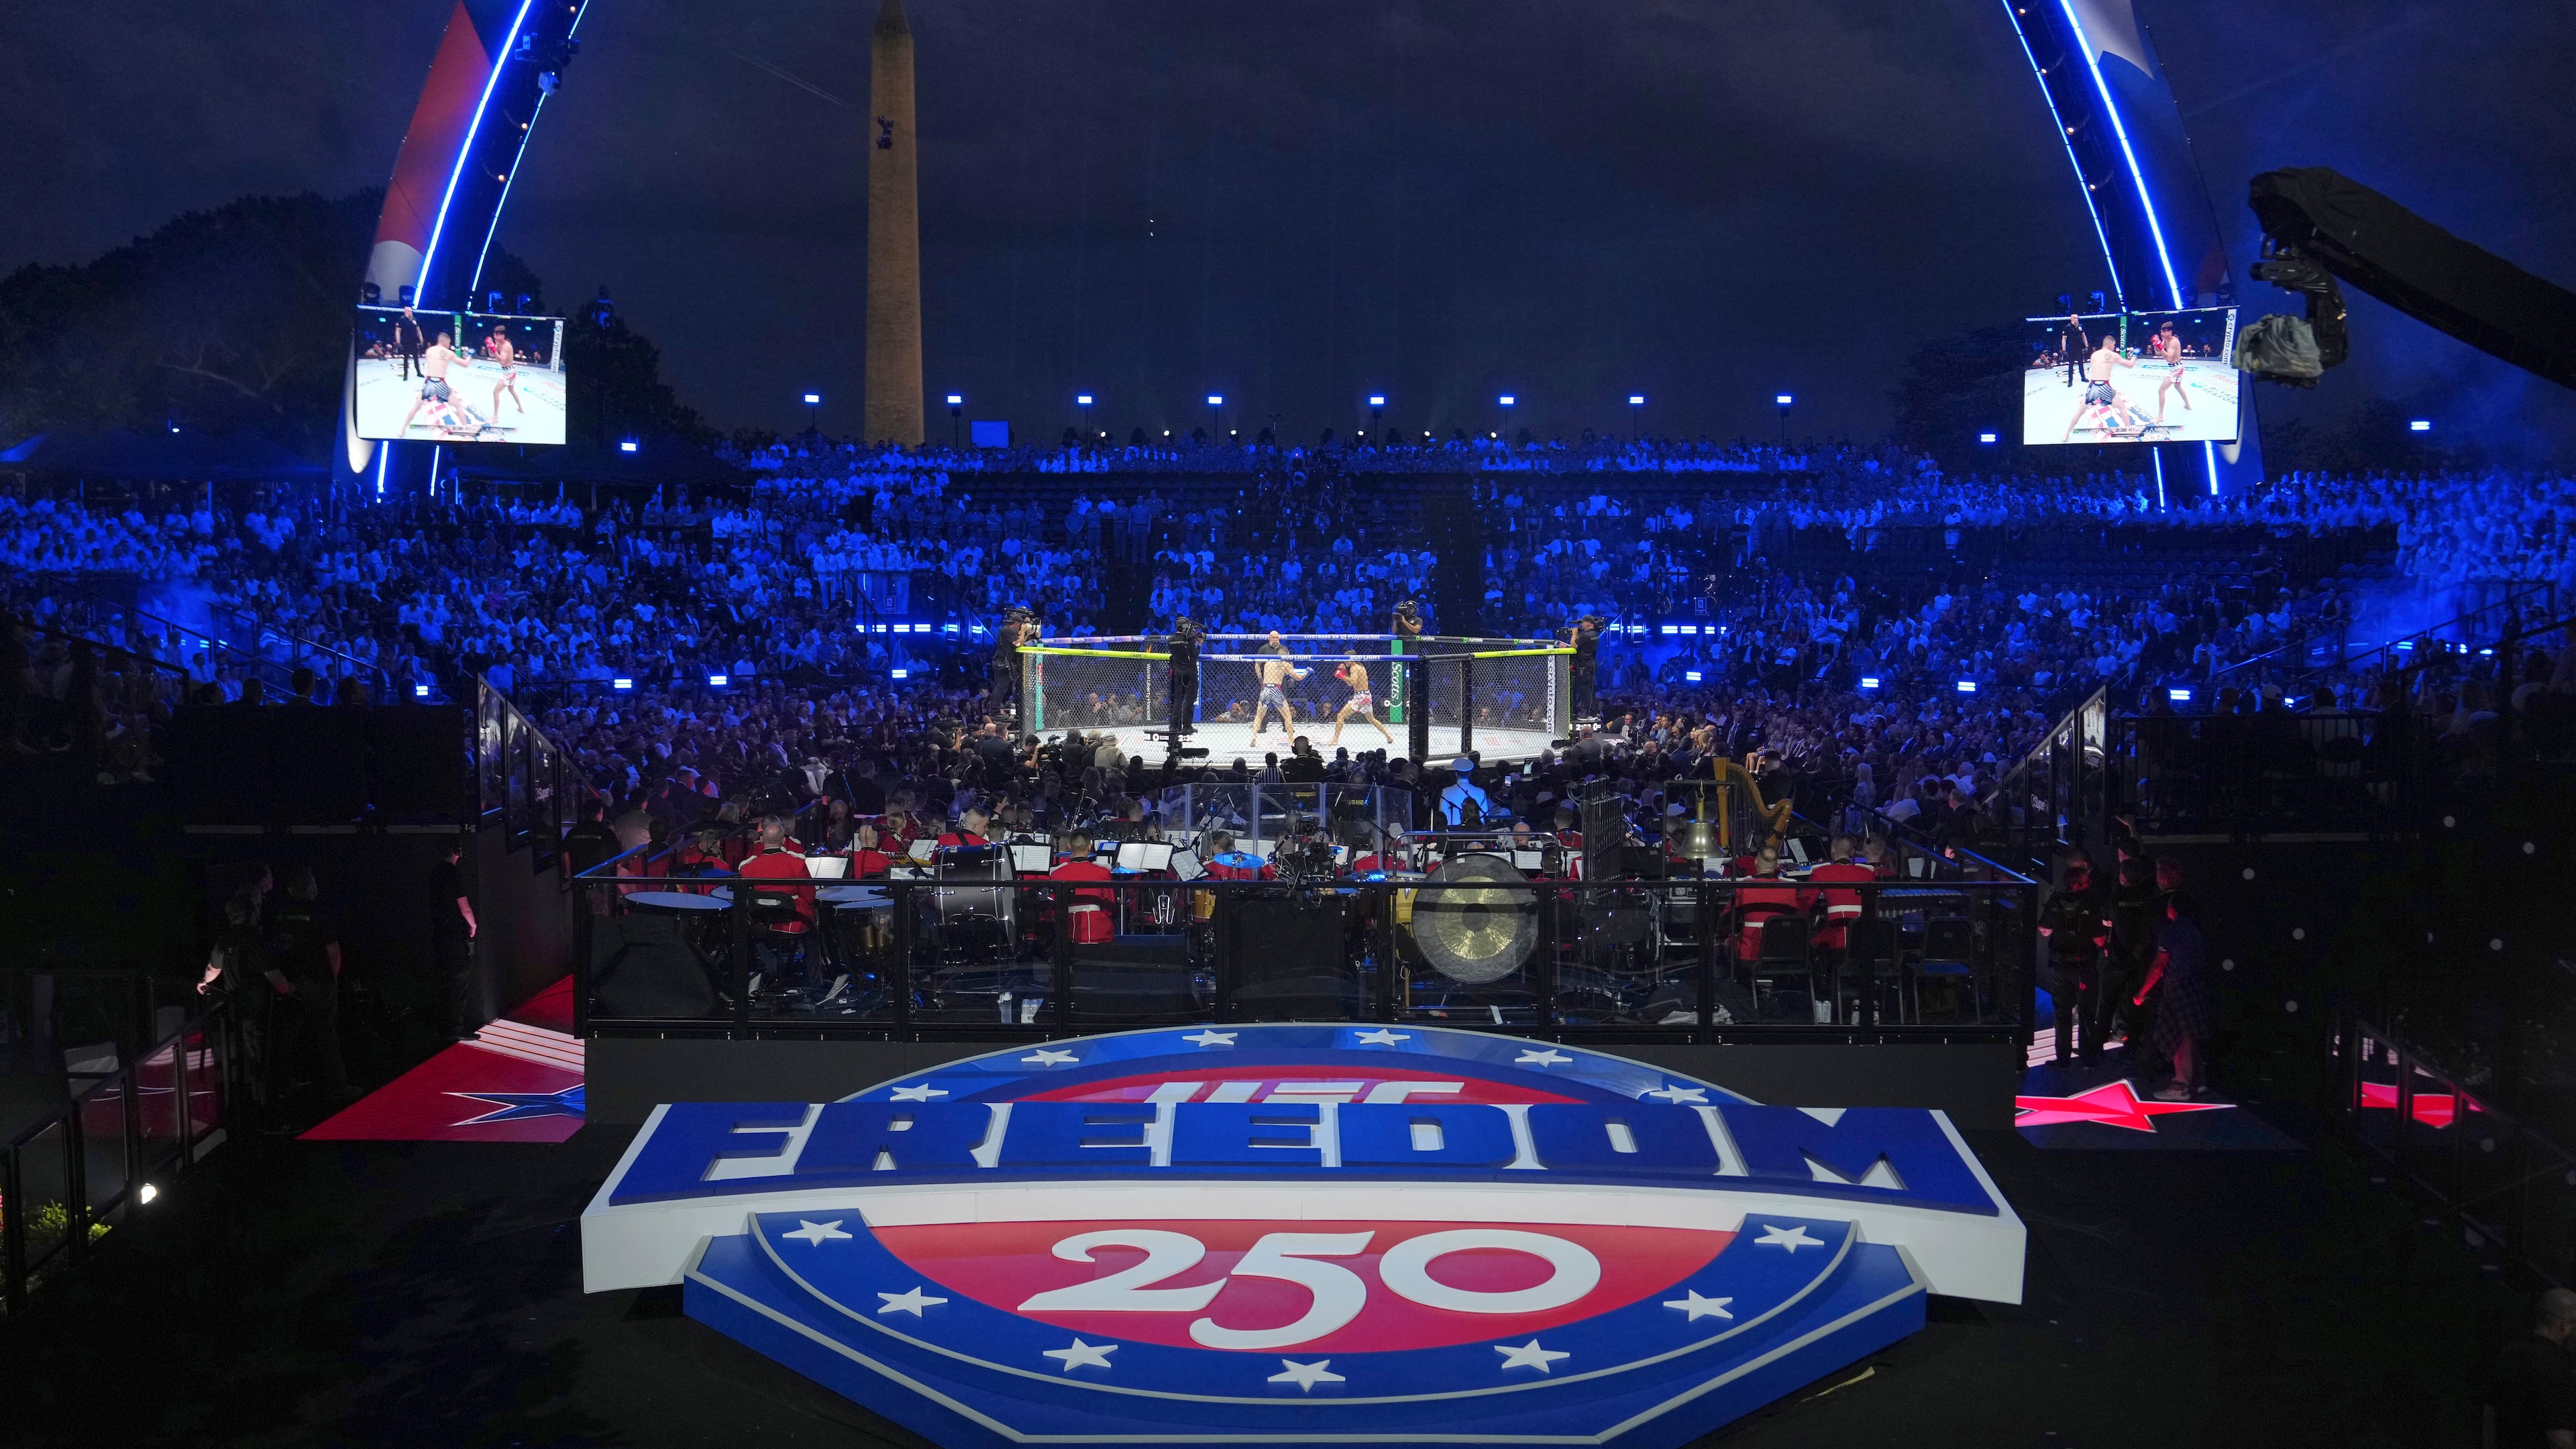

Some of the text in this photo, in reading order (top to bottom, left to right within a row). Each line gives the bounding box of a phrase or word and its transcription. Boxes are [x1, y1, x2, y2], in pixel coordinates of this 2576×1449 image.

[2223, 323, 2233, 364] crypto.com
[609, 1101, 2001, 1217] FREEDOM
[1017, 1228, 1601, 1350] 250
